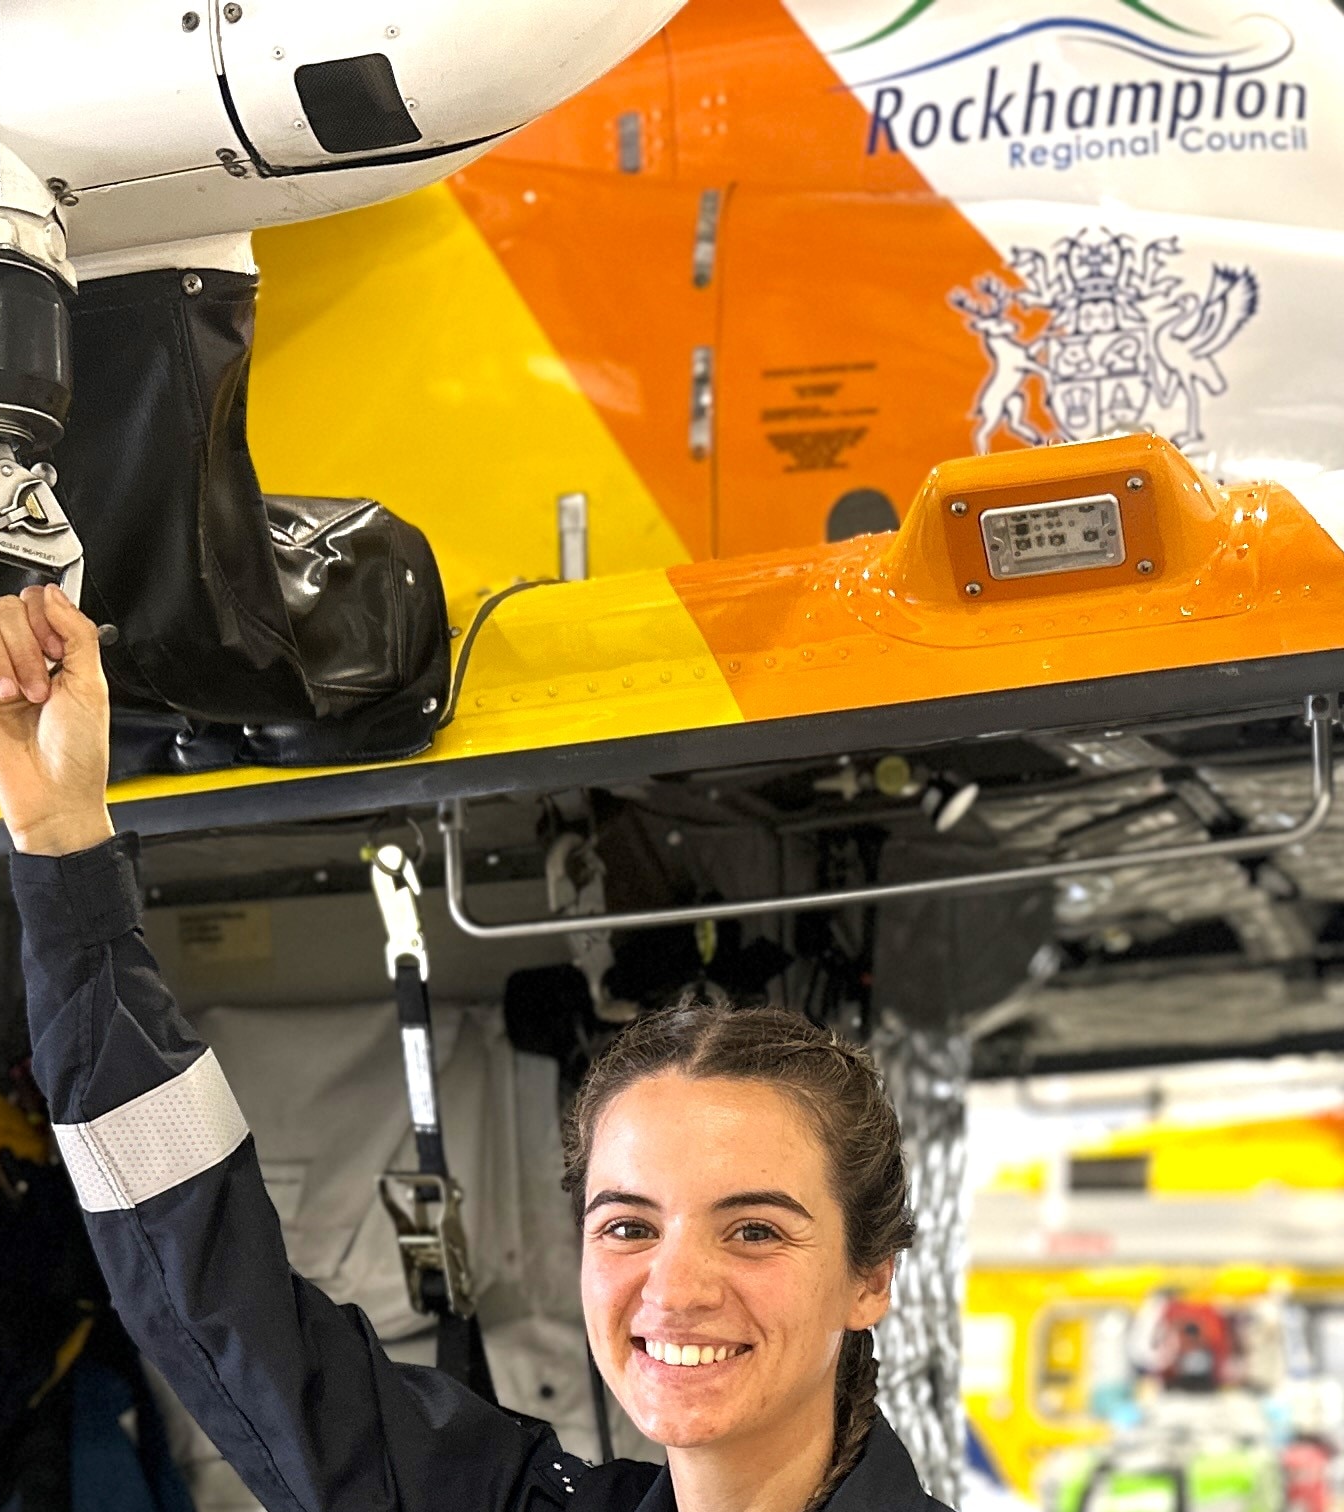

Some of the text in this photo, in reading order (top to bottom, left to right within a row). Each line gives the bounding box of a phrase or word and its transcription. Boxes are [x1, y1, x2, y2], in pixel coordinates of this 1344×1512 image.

[866, 63, 1307, 156] Rockhampton
[1009, 126, 1308, 170] Regional Council
